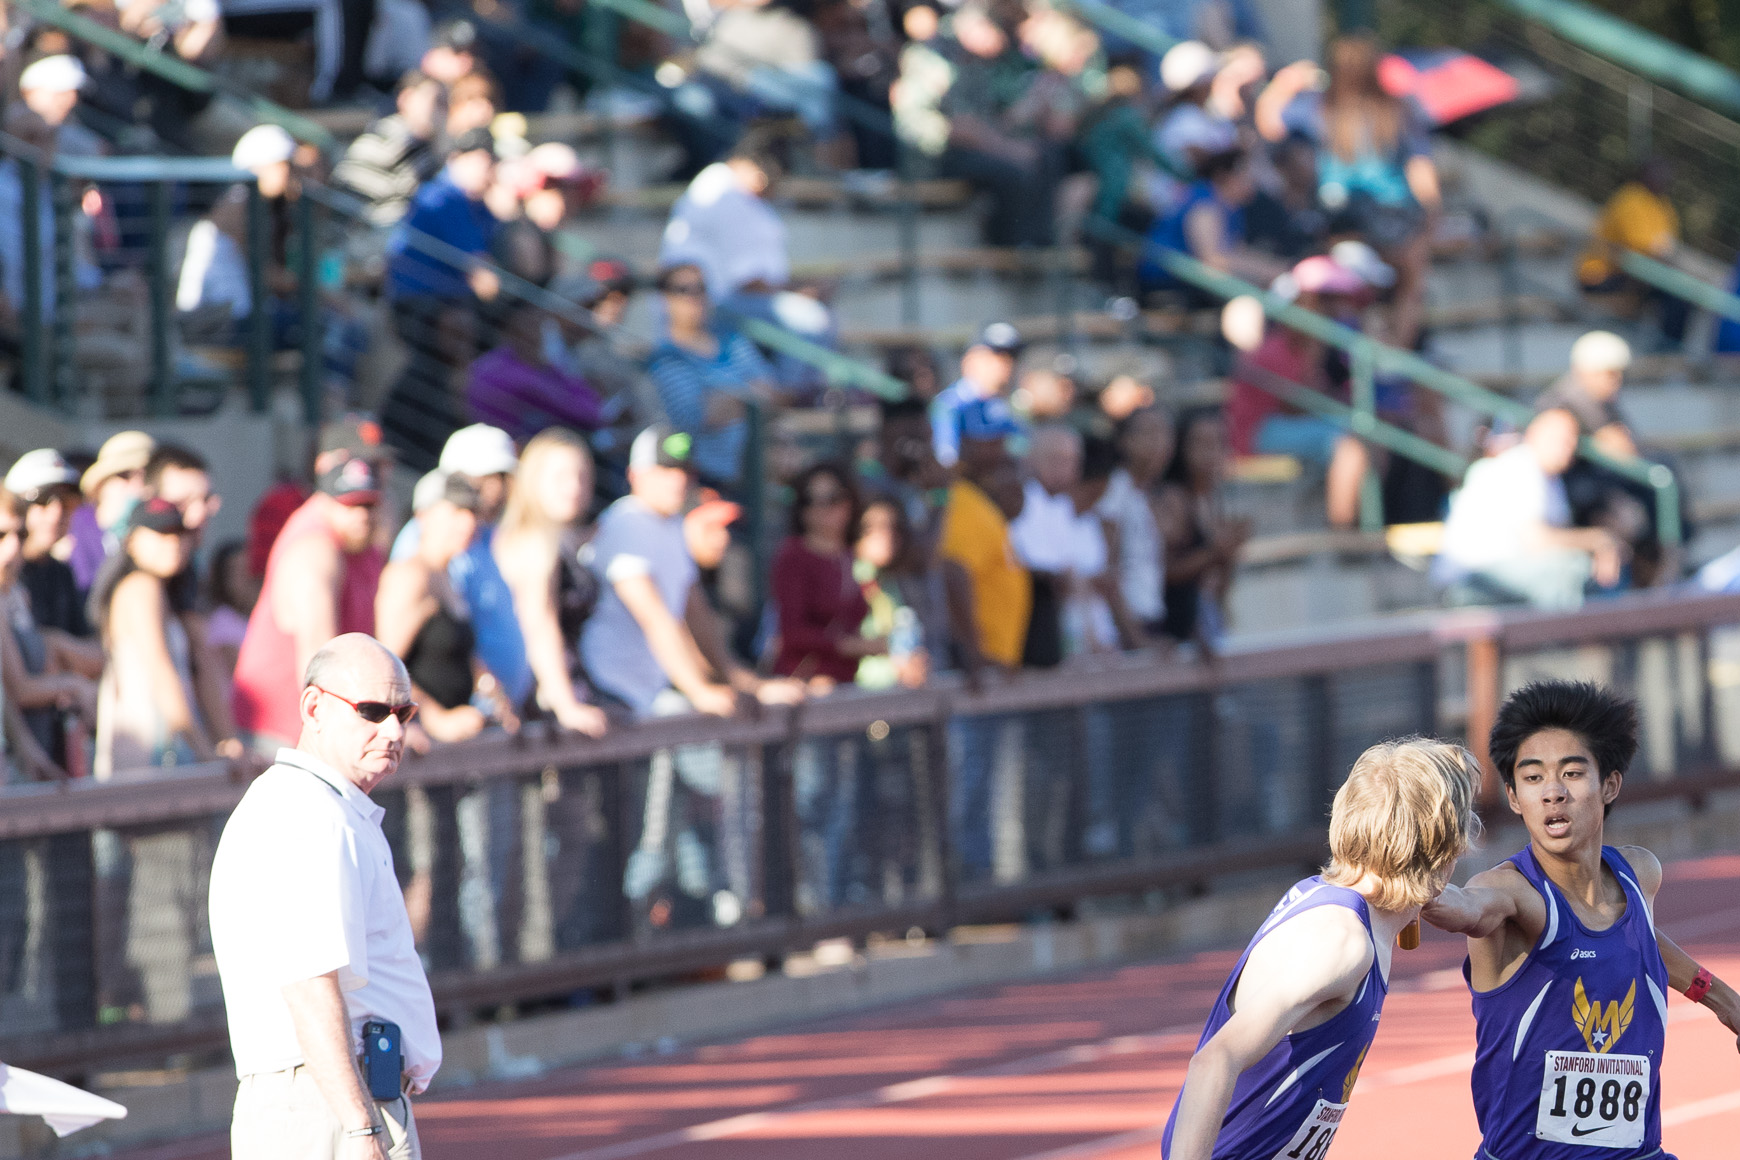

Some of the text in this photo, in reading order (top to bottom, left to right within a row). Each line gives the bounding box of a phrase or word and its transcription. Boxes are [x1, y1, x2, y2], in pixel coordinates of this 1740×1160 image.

[1579, 950, 1596, 959] asics
[1554, 1055, 1644, 1076] STANFORD INVITATIONAL
[1550, 1075, 1642, 1122] 1888
